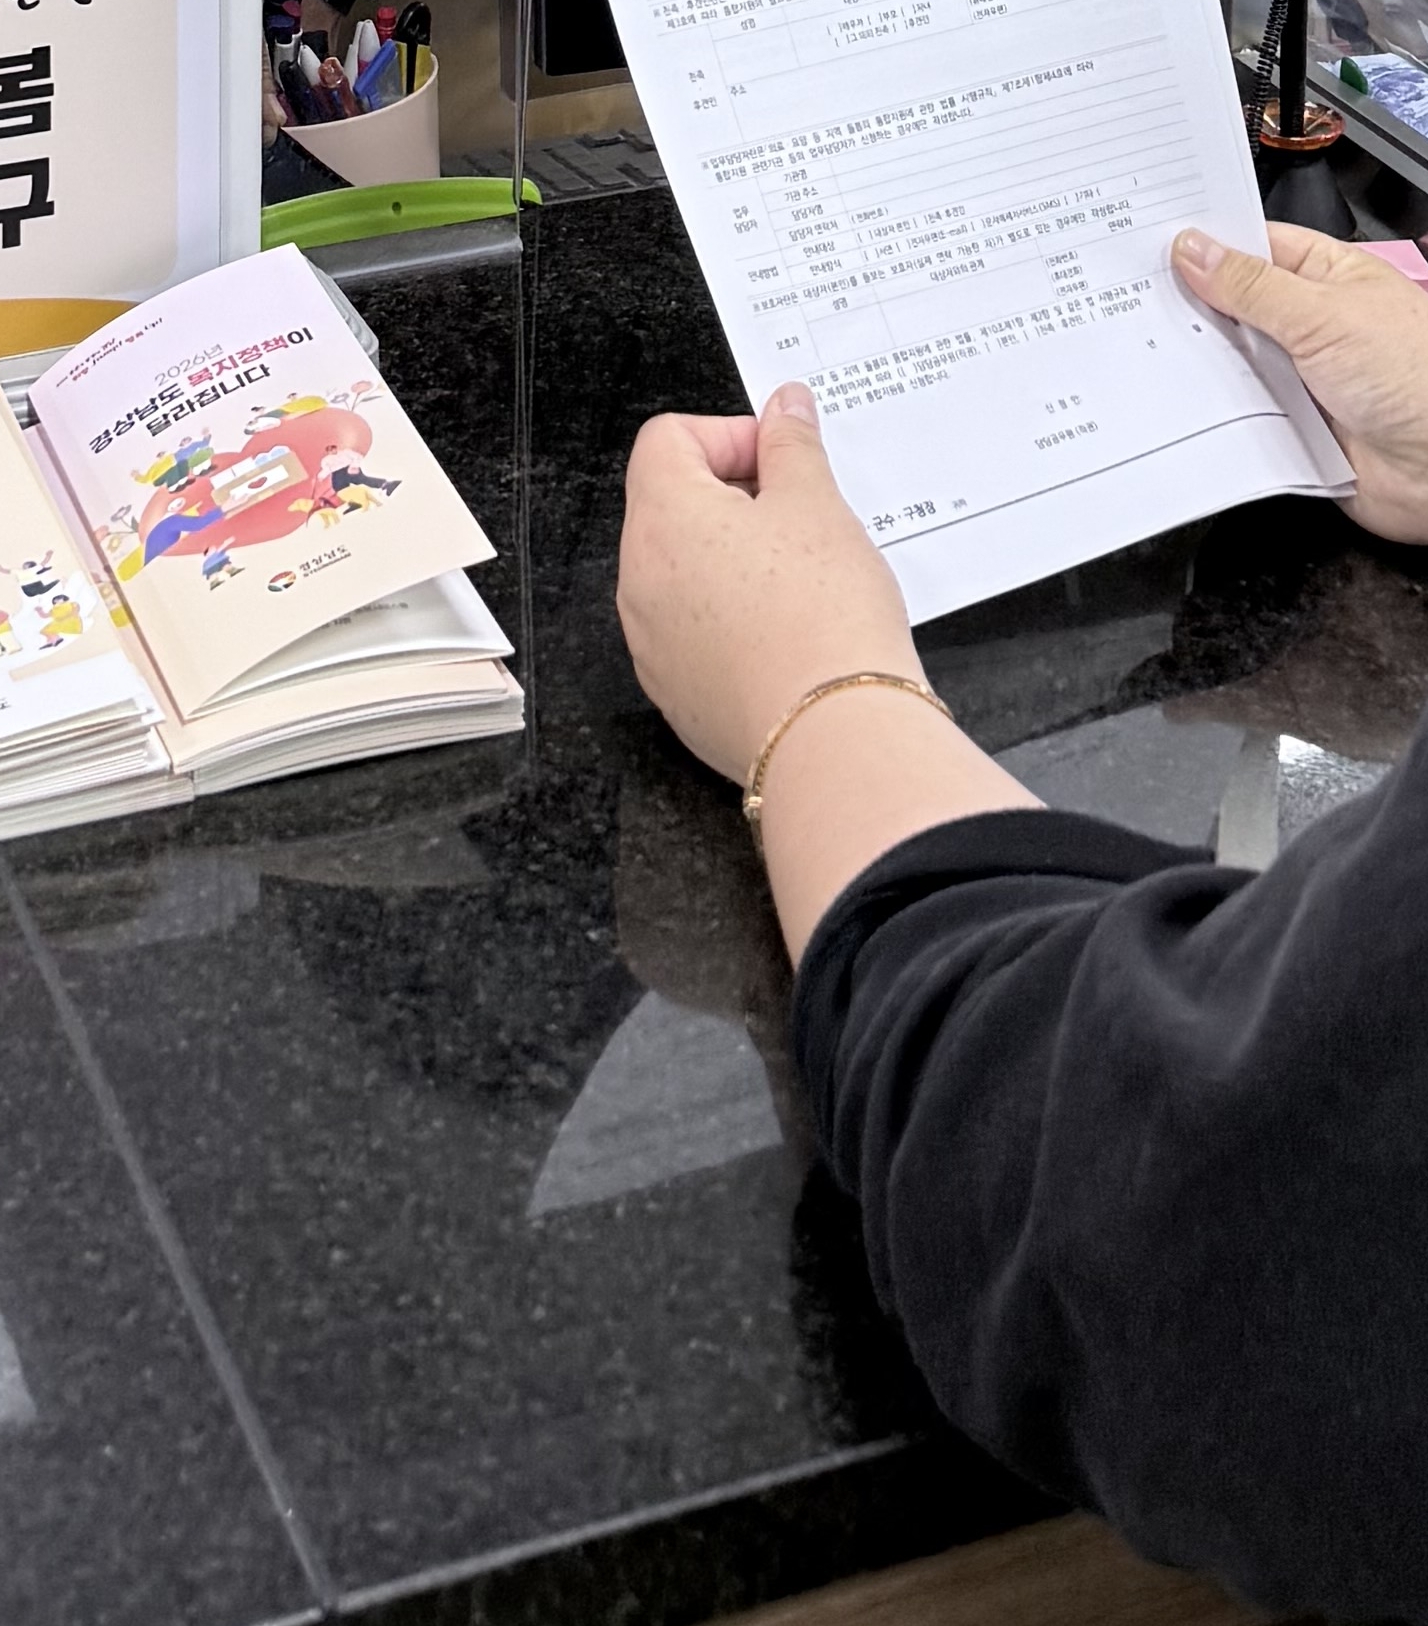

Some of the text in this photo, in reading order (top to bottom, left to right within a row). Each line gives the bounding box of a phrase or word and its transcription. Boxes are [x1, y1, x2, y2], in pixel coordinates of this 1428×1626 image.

[90, 383, 185, 453] 경상남도
[186, 328, 313, 386] 복지정책이
[146, 364, 270, 436] 달라집니다
[155, 344, 224, 386] 2026년
